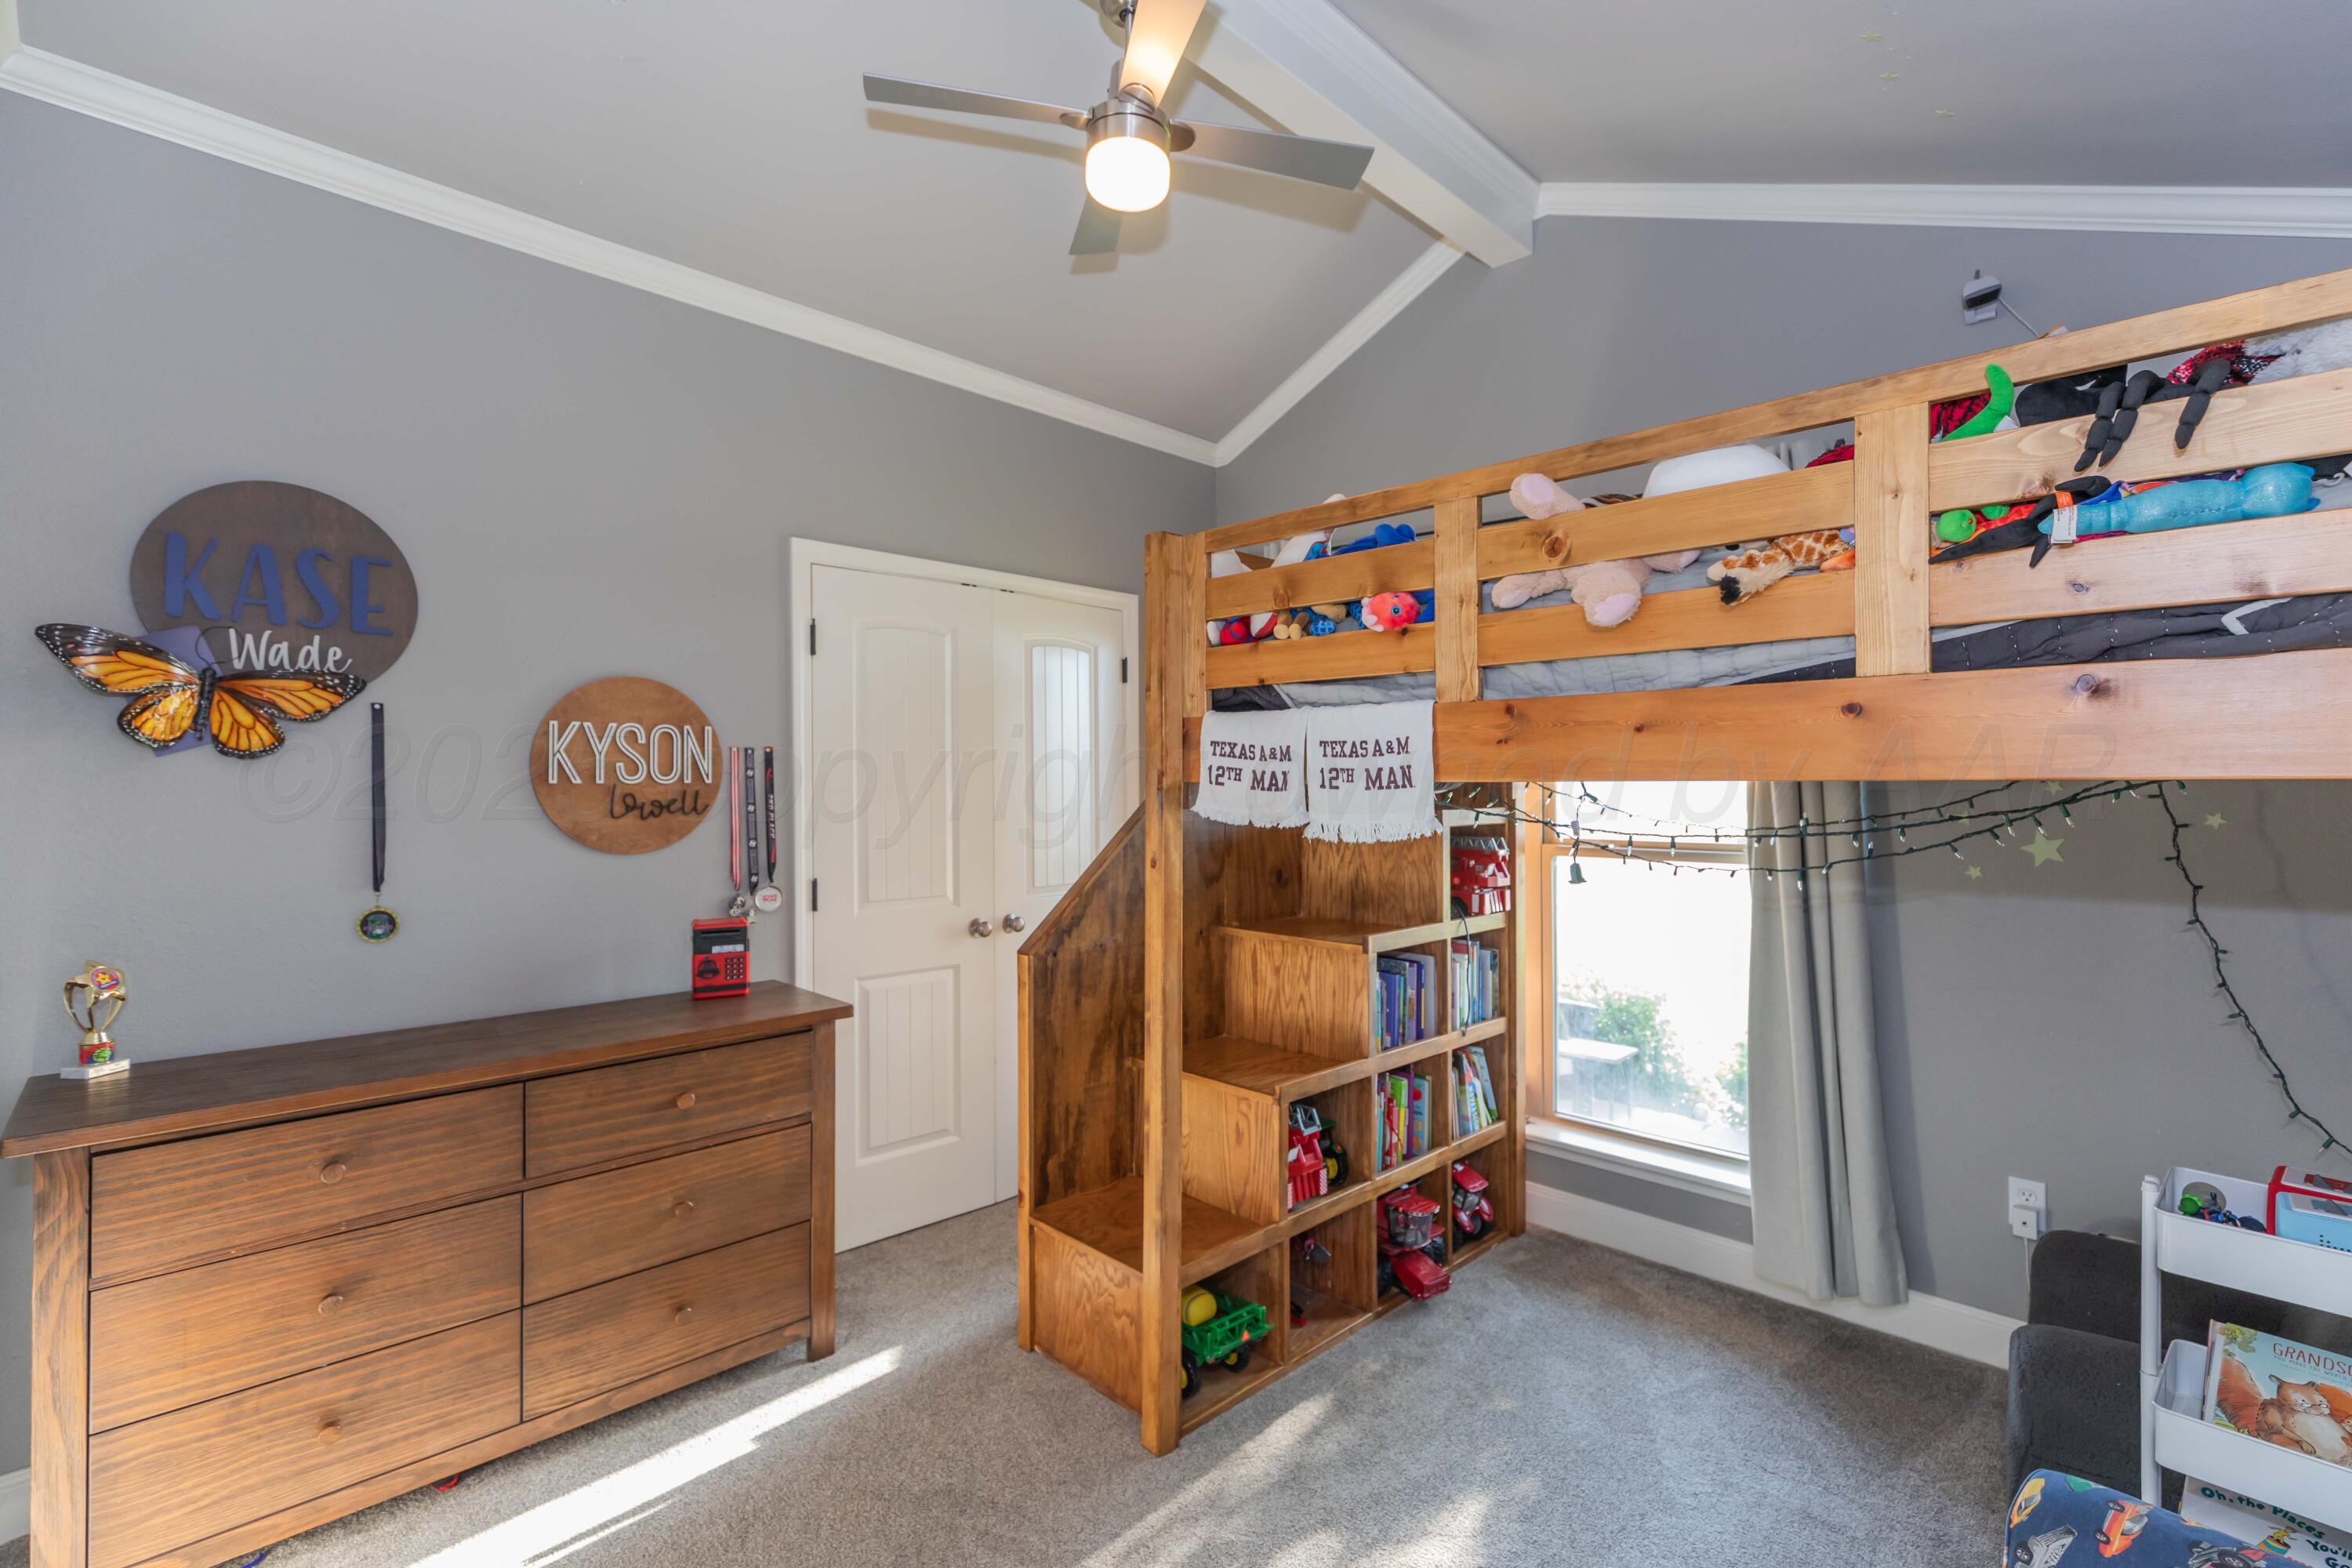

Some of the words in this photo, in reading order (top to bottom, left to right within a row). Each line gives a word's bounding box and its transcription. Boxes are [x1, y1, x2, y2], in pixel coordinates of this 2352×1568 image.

[163, 530, 394, 636] KASE
[228, 627, 352, 673] Wade
[548, 720, 713, 785] KYSON
[1210, 740, 1255, 760] TEXAS
[1319, 740, 1368, 758] TEXAS
[1208, 764, 1243, 786] 12TH
[1250, 768, 1290, 792] MAN
[1319, 767, 1355, 790] 12TH
[1365, 764, 1414, 791] MAN
[2237, 1496, 2266, 1511] the
[2270, 1504, 2326, 1540] Places
